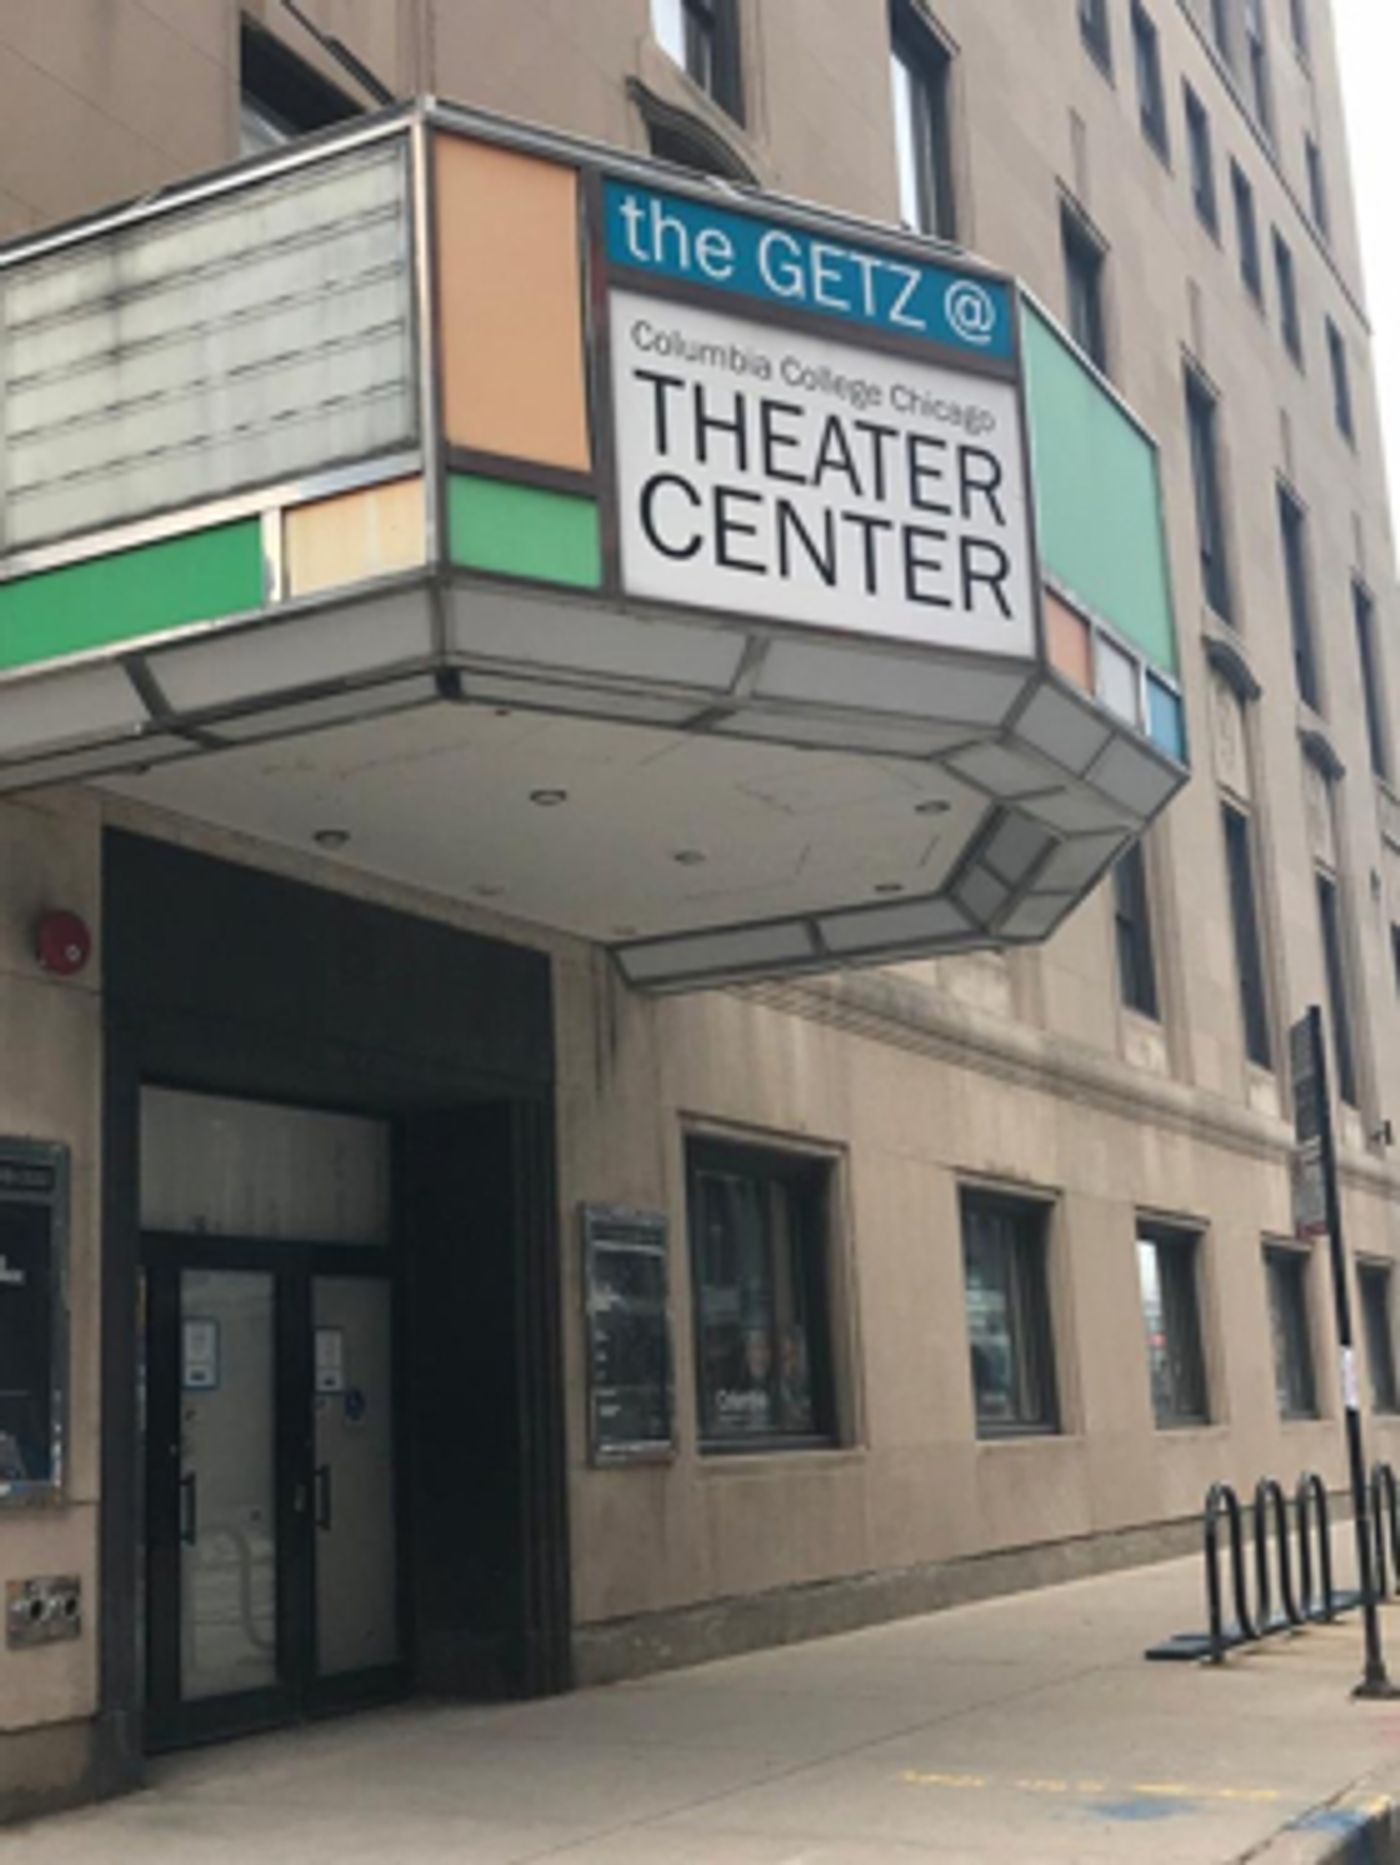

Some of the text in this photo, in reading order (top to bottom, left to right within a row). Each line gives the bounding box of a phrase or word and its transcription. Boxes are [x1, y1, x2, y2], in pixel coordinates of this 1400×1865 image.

[620, 195, 996, 345] the GETZ @
[630, 319, 996, 437] Columbia College Chicago
[633, 368, 1006, 527] THEATER
[639, 472, 1013, 620] CENTER
